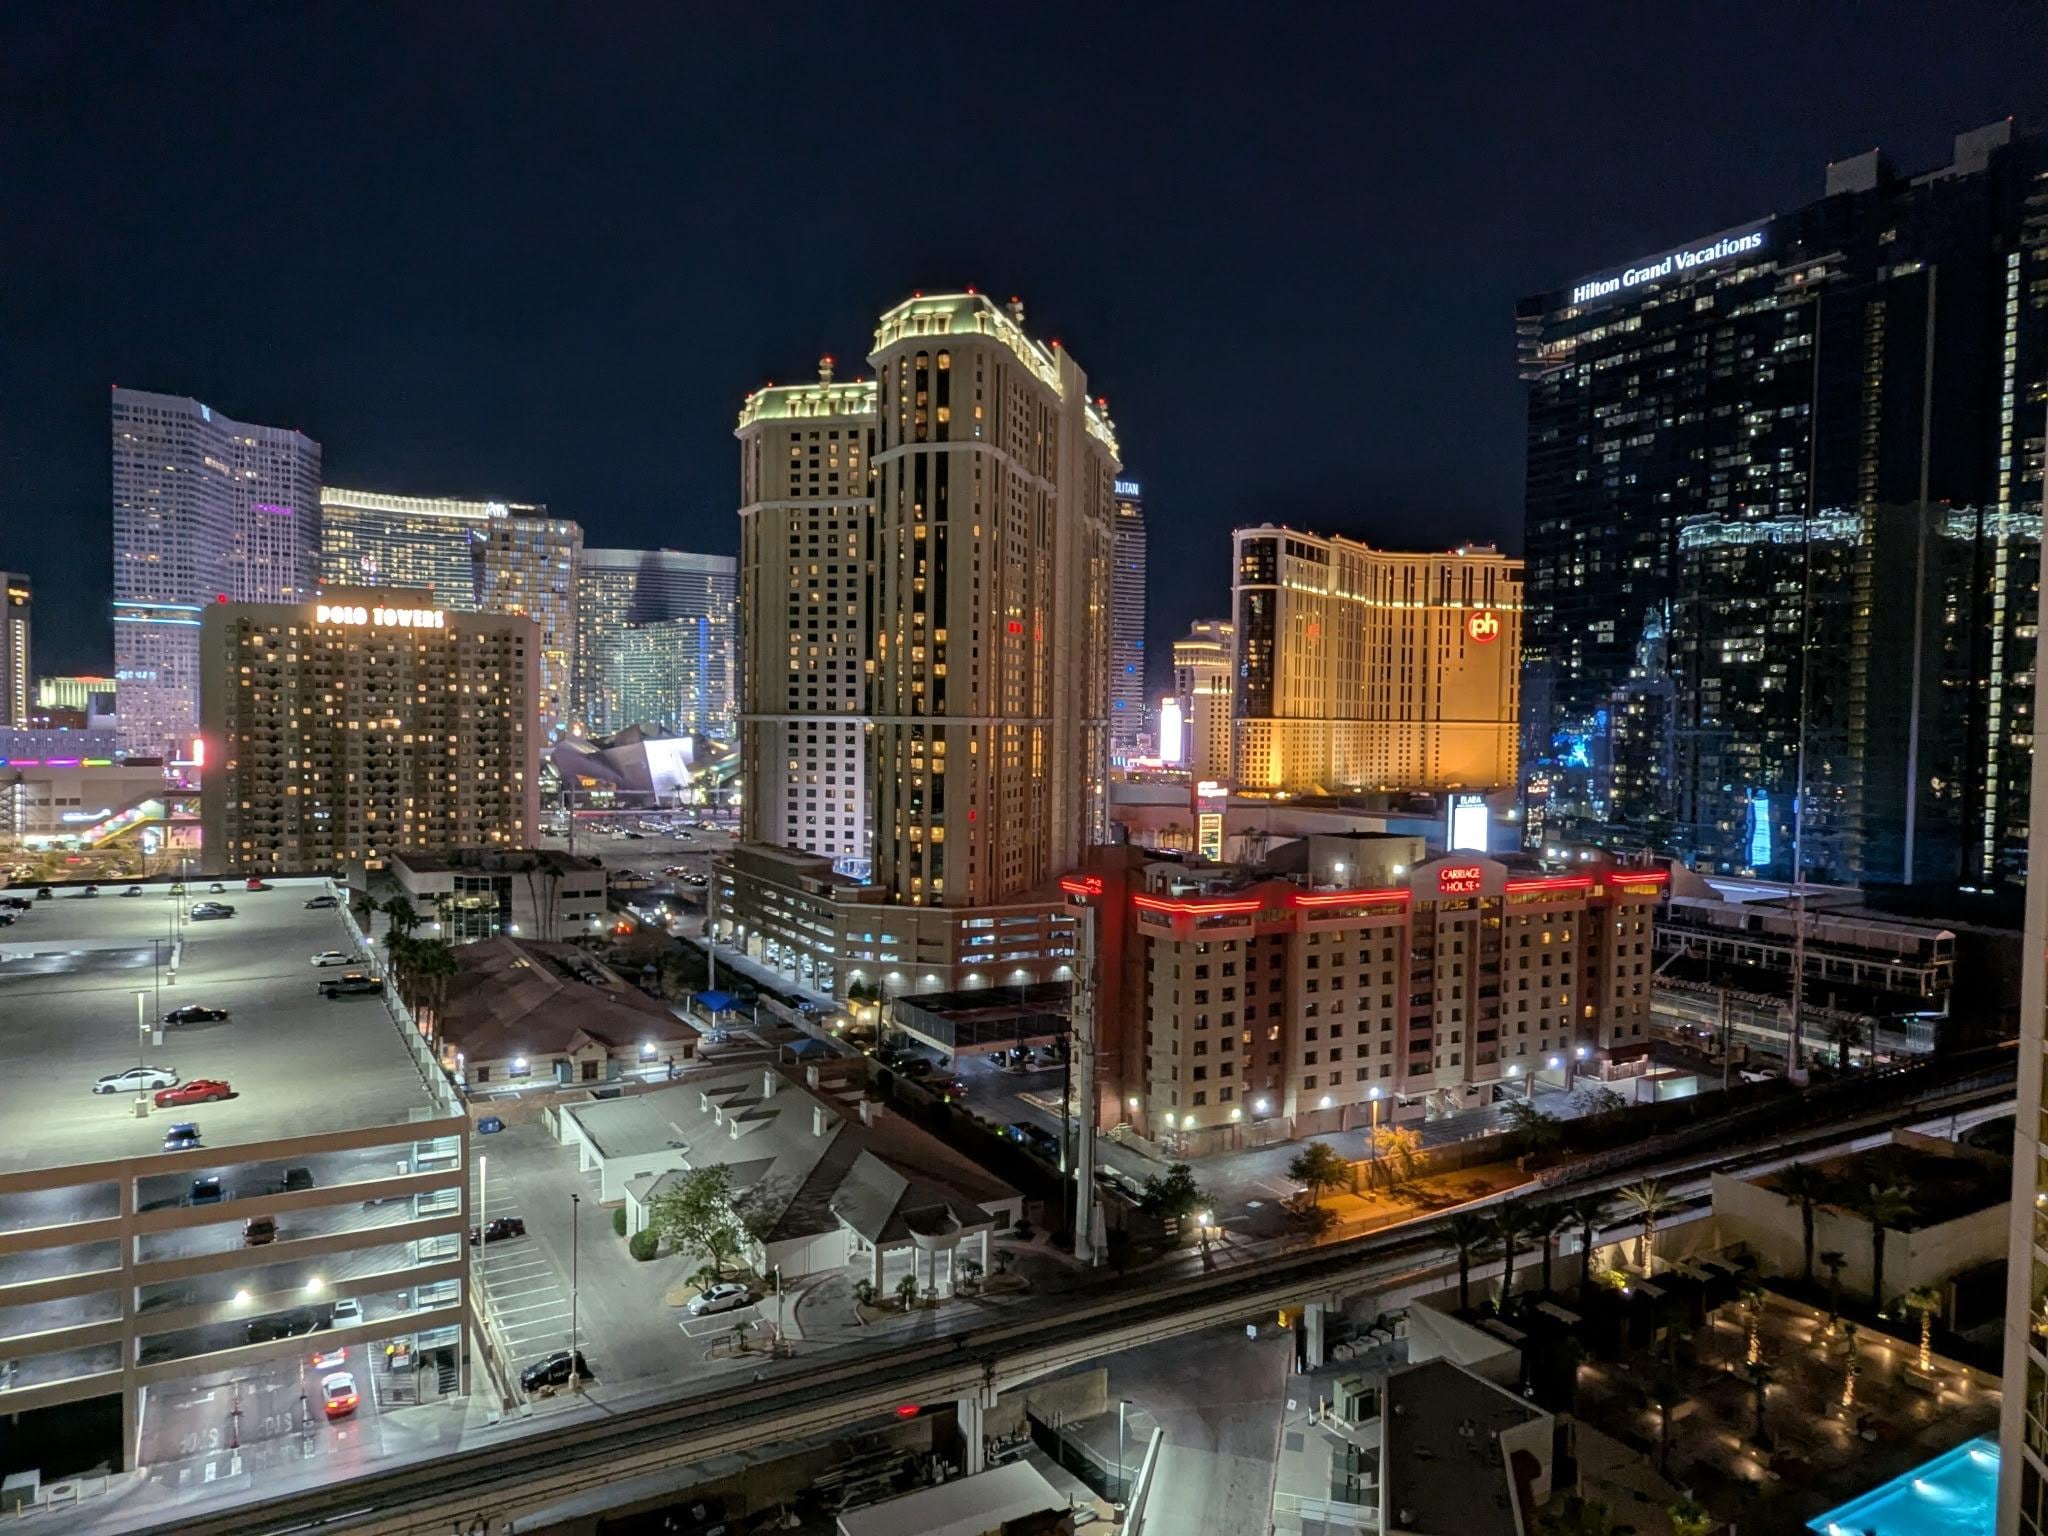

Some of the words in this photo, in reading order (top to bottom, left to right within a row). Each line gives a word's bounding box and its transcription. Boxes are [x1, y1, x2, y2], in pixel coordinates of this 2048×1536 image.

[1573, 277, 1620, 304] Hilton
[1622, 256, 1671, 287] Grand
[1674, 232, 1762, 270] Vacations
[316, 605, 368, 625] POLO
[372, 607, 445, 628] TOWERS
[1472, 611, 1499, 638] ph
[1441, 868, 1480, 880] CARRIAGE
[1446, 881, 1475, 892] HOUSE
